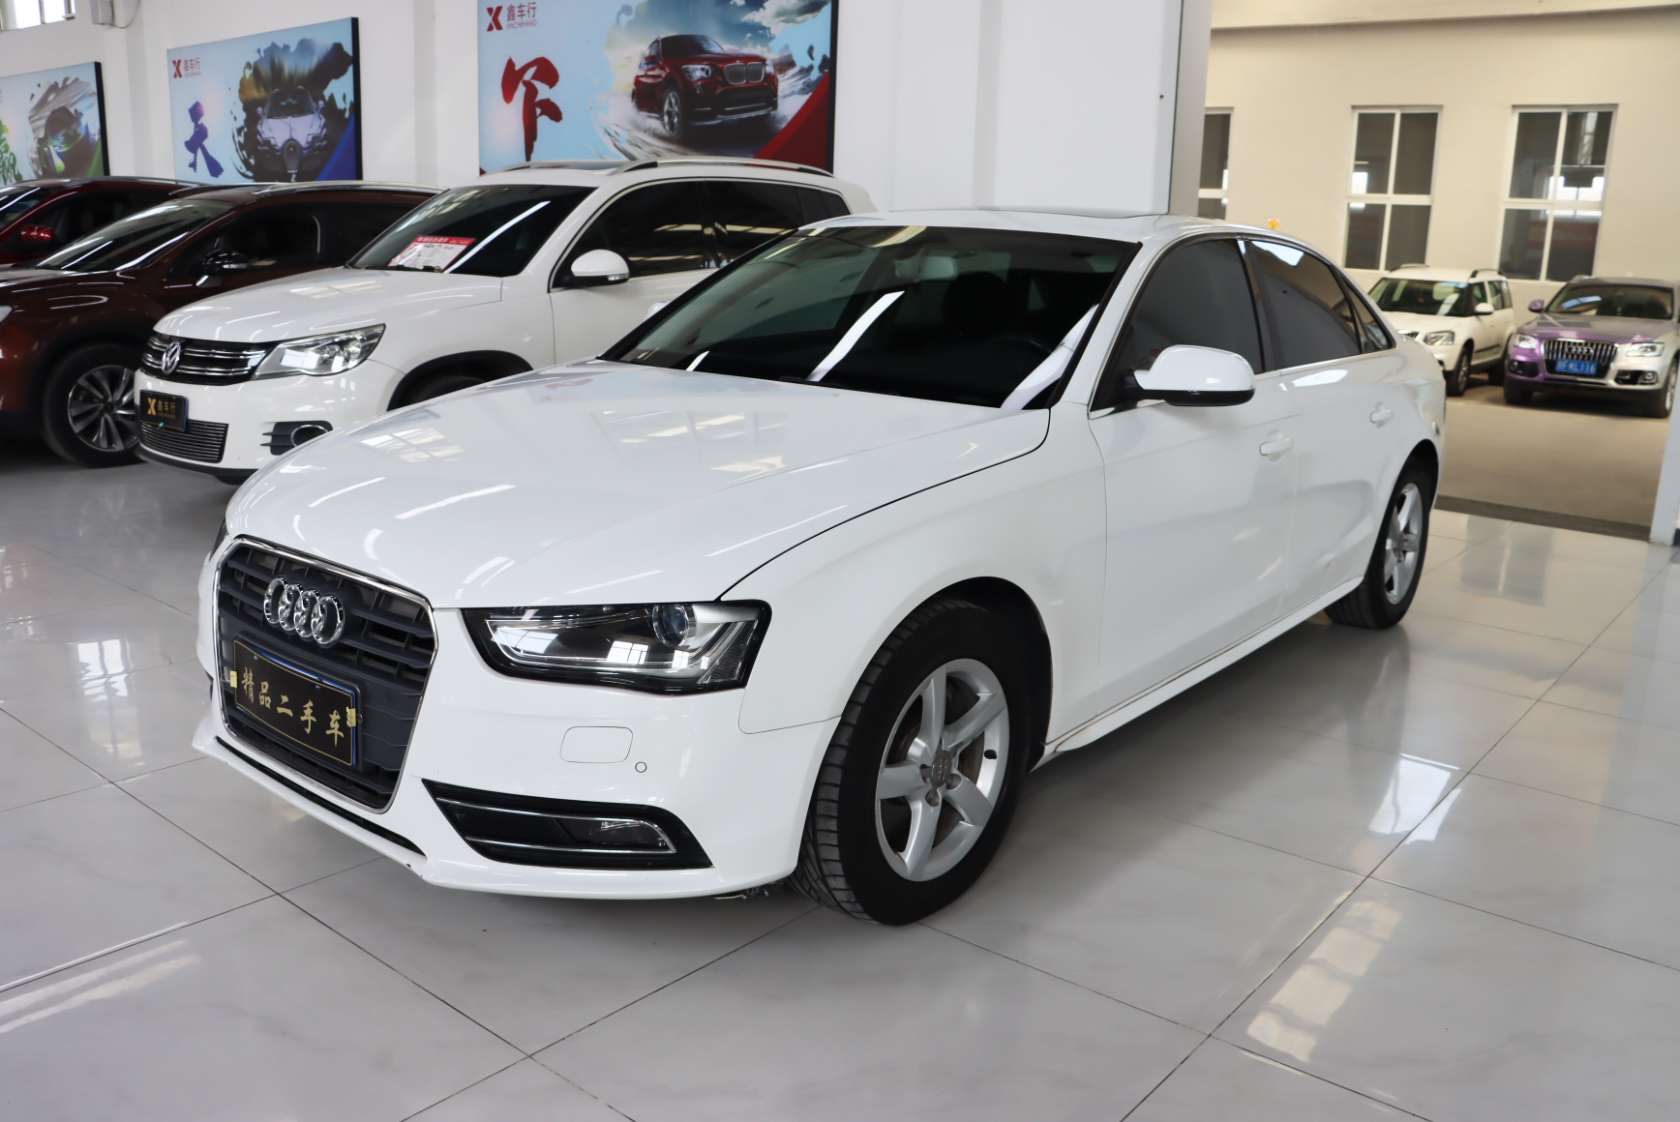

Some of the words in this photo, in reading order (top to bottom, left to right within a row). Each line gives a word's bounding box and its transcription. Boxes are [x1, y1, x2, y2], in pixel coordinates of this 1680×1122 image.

[242, 667, 344, 746] 精品二手车
